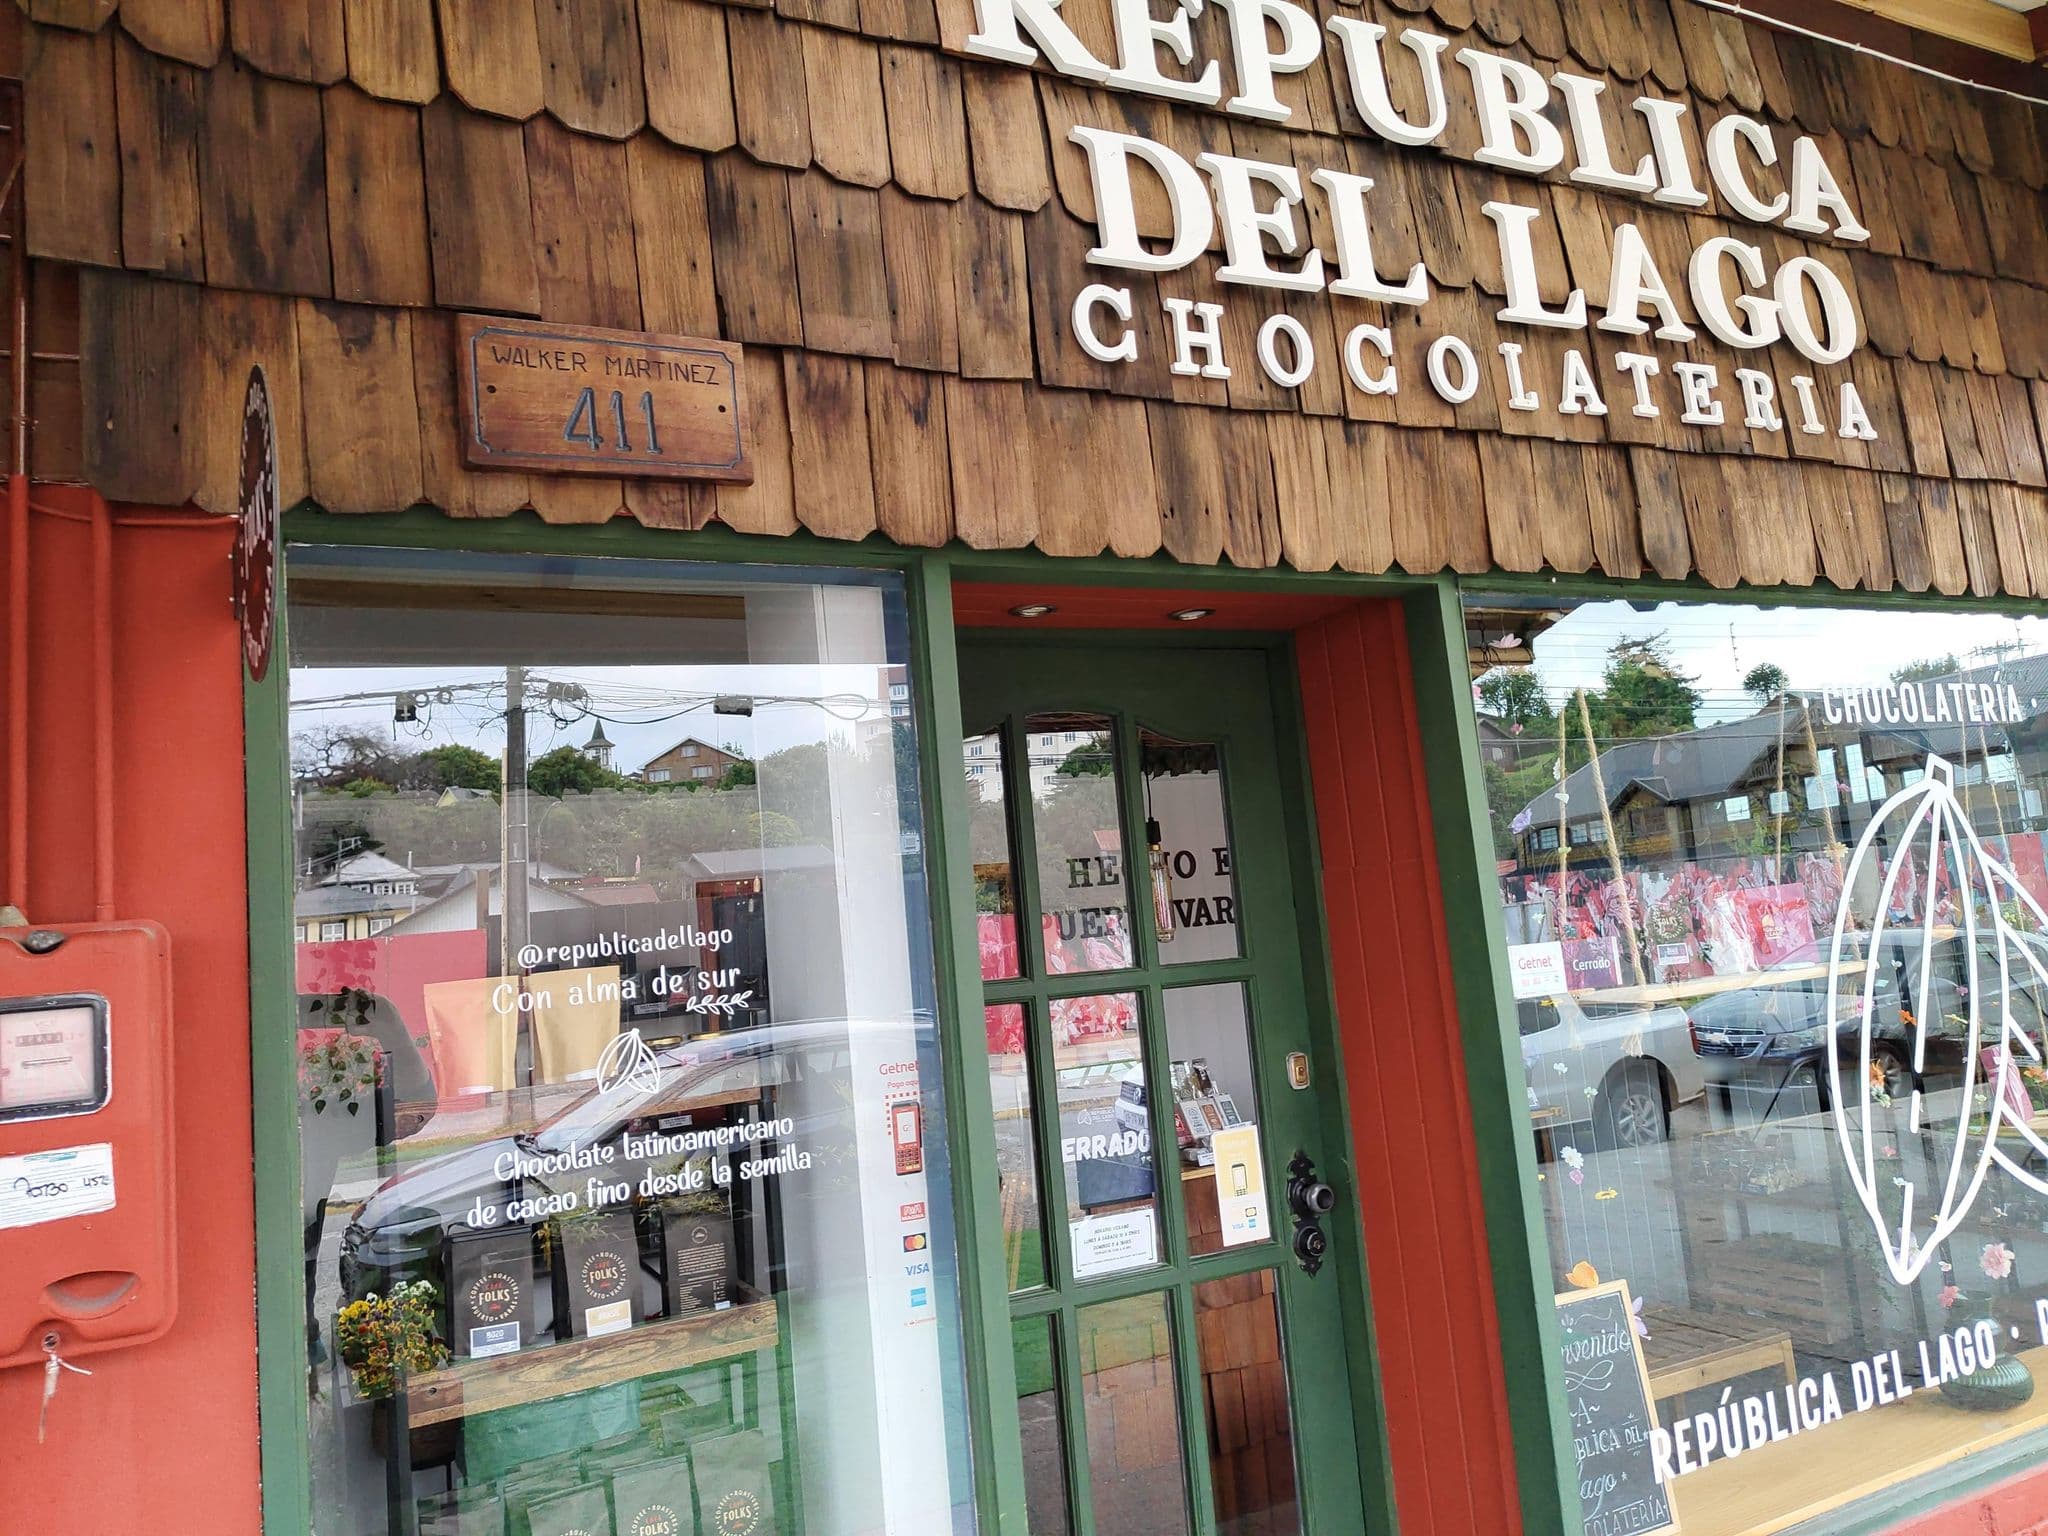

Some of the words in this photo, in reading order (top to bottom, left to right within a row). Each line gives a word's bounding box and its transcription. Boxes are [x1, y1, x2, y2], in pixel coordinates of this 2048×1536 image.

[1068, 125, 1430, 306] DEL
[1481, 201, 1857, 365] LAGO
[491, 345, 588, 373] WALKER
[604, 355, 720, 386] MARTINEZ
[1071, 283, 1878, 440] CHOCOLATERIA
[563, 387, 663, 455] 411
[1822, 670, 2024, 724] CHOCOLATERÍA
[517, 924, 733, 968] @republicadellago
[1518, 955, 1553, 970] Getnet
[1572, 954, 1611, 972] Cerrado
[492, 983, 552, 1015] Con
[569, 974, 637, 1006] alma
[652, 964, 684, 995] de
[697, 967, 741, 991] sur
[879, 1060, 920, 1075] Getnet
[493, 1140, 615, 1184] Chocolate
[623, 1115, 794, 1161] latinoamericano
[1061, 1127, 1152, 1163] ERRADO
[466, 1197, 497, 1229] de
[505, 1190, 578, 1224] cacao
[586, 1177, 631, 1209] fino
[639, 1161, 704, 1198] desde
[711, 1158, 732, 1185] la
[739, 1145, 812, 1180] semilla
[589, 1266, 618, 1284] FOLKS
[904, 1262, 930, 1276] VISA
[478, 1288, 510, 1306] FOLKS
[1649, 1370, 1843, 1485] REPÚBLICA
[1850, 1349, 1913, 1413] DEL
[1919, 1320, 1997, 1390] LAGO
[639, 1521, 670, 1536] FOLKS
[723, 1505, 752, 1525] FOLKS
